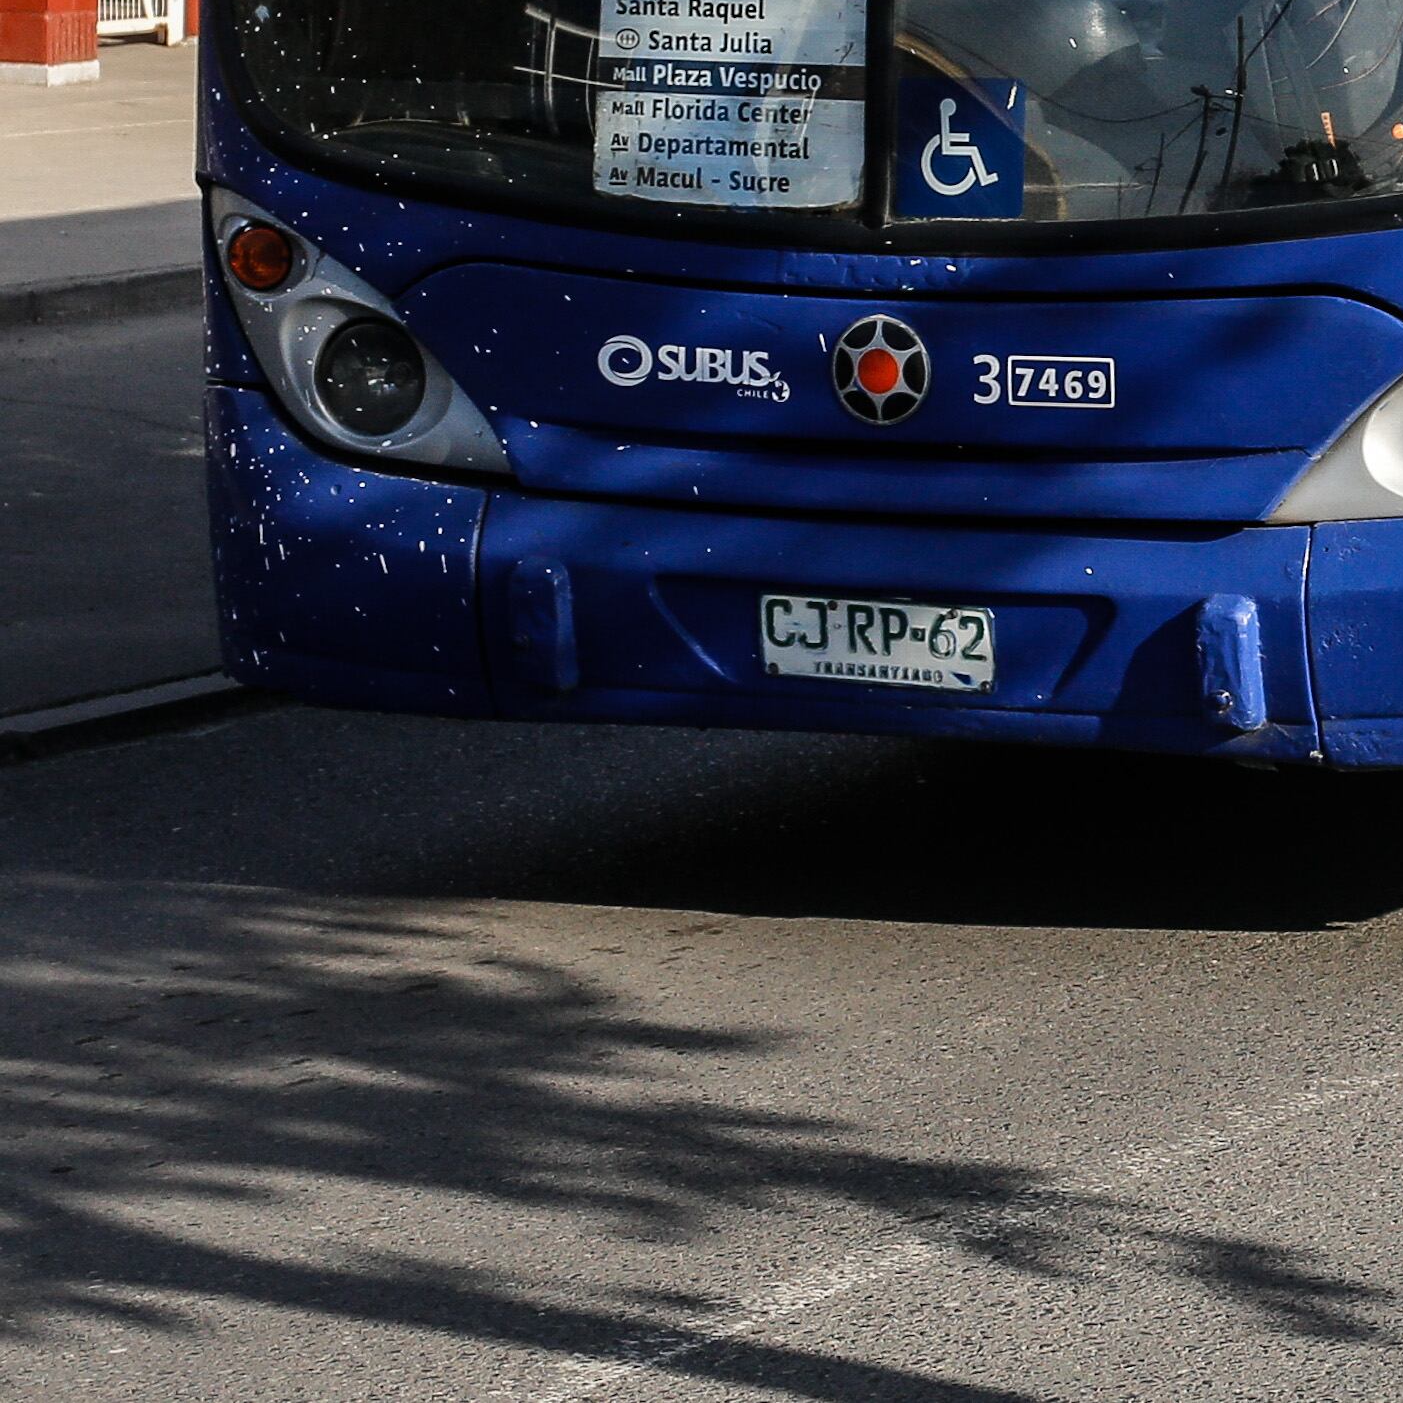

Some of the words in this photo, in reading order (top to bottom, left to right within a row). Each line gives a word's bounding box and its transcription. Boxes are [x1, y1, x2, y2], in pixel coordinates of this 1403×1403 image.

[648, 30, 712, 52] Santa
[719, 32, 773, 54] Julia
[613, 66, 647, 82] Mall
[652, 63, 712, 87] Plaza
[718, 66, 822, 95] Vespucio
[611, 101, 645, 116] Mall
[651, 98, 730, 122] Florida
[737, 102, 813, 125] Center
[610, 133, 629, 150] Av
[638, 132, 810, 160] Departamental
[609, 167, 628, 184] Av
[636, 166, 703, 189] Macul
[728, 170, 790, 193] Sucre
[657, 344, 772, 387] SUBUS
[973, 354, 1001, 404] 3
[1015, 367, 1107, 400] 7469
[736, 388, 769, 399] CHILE
[813, 661, 943, 684] TRANSANTIAGO
